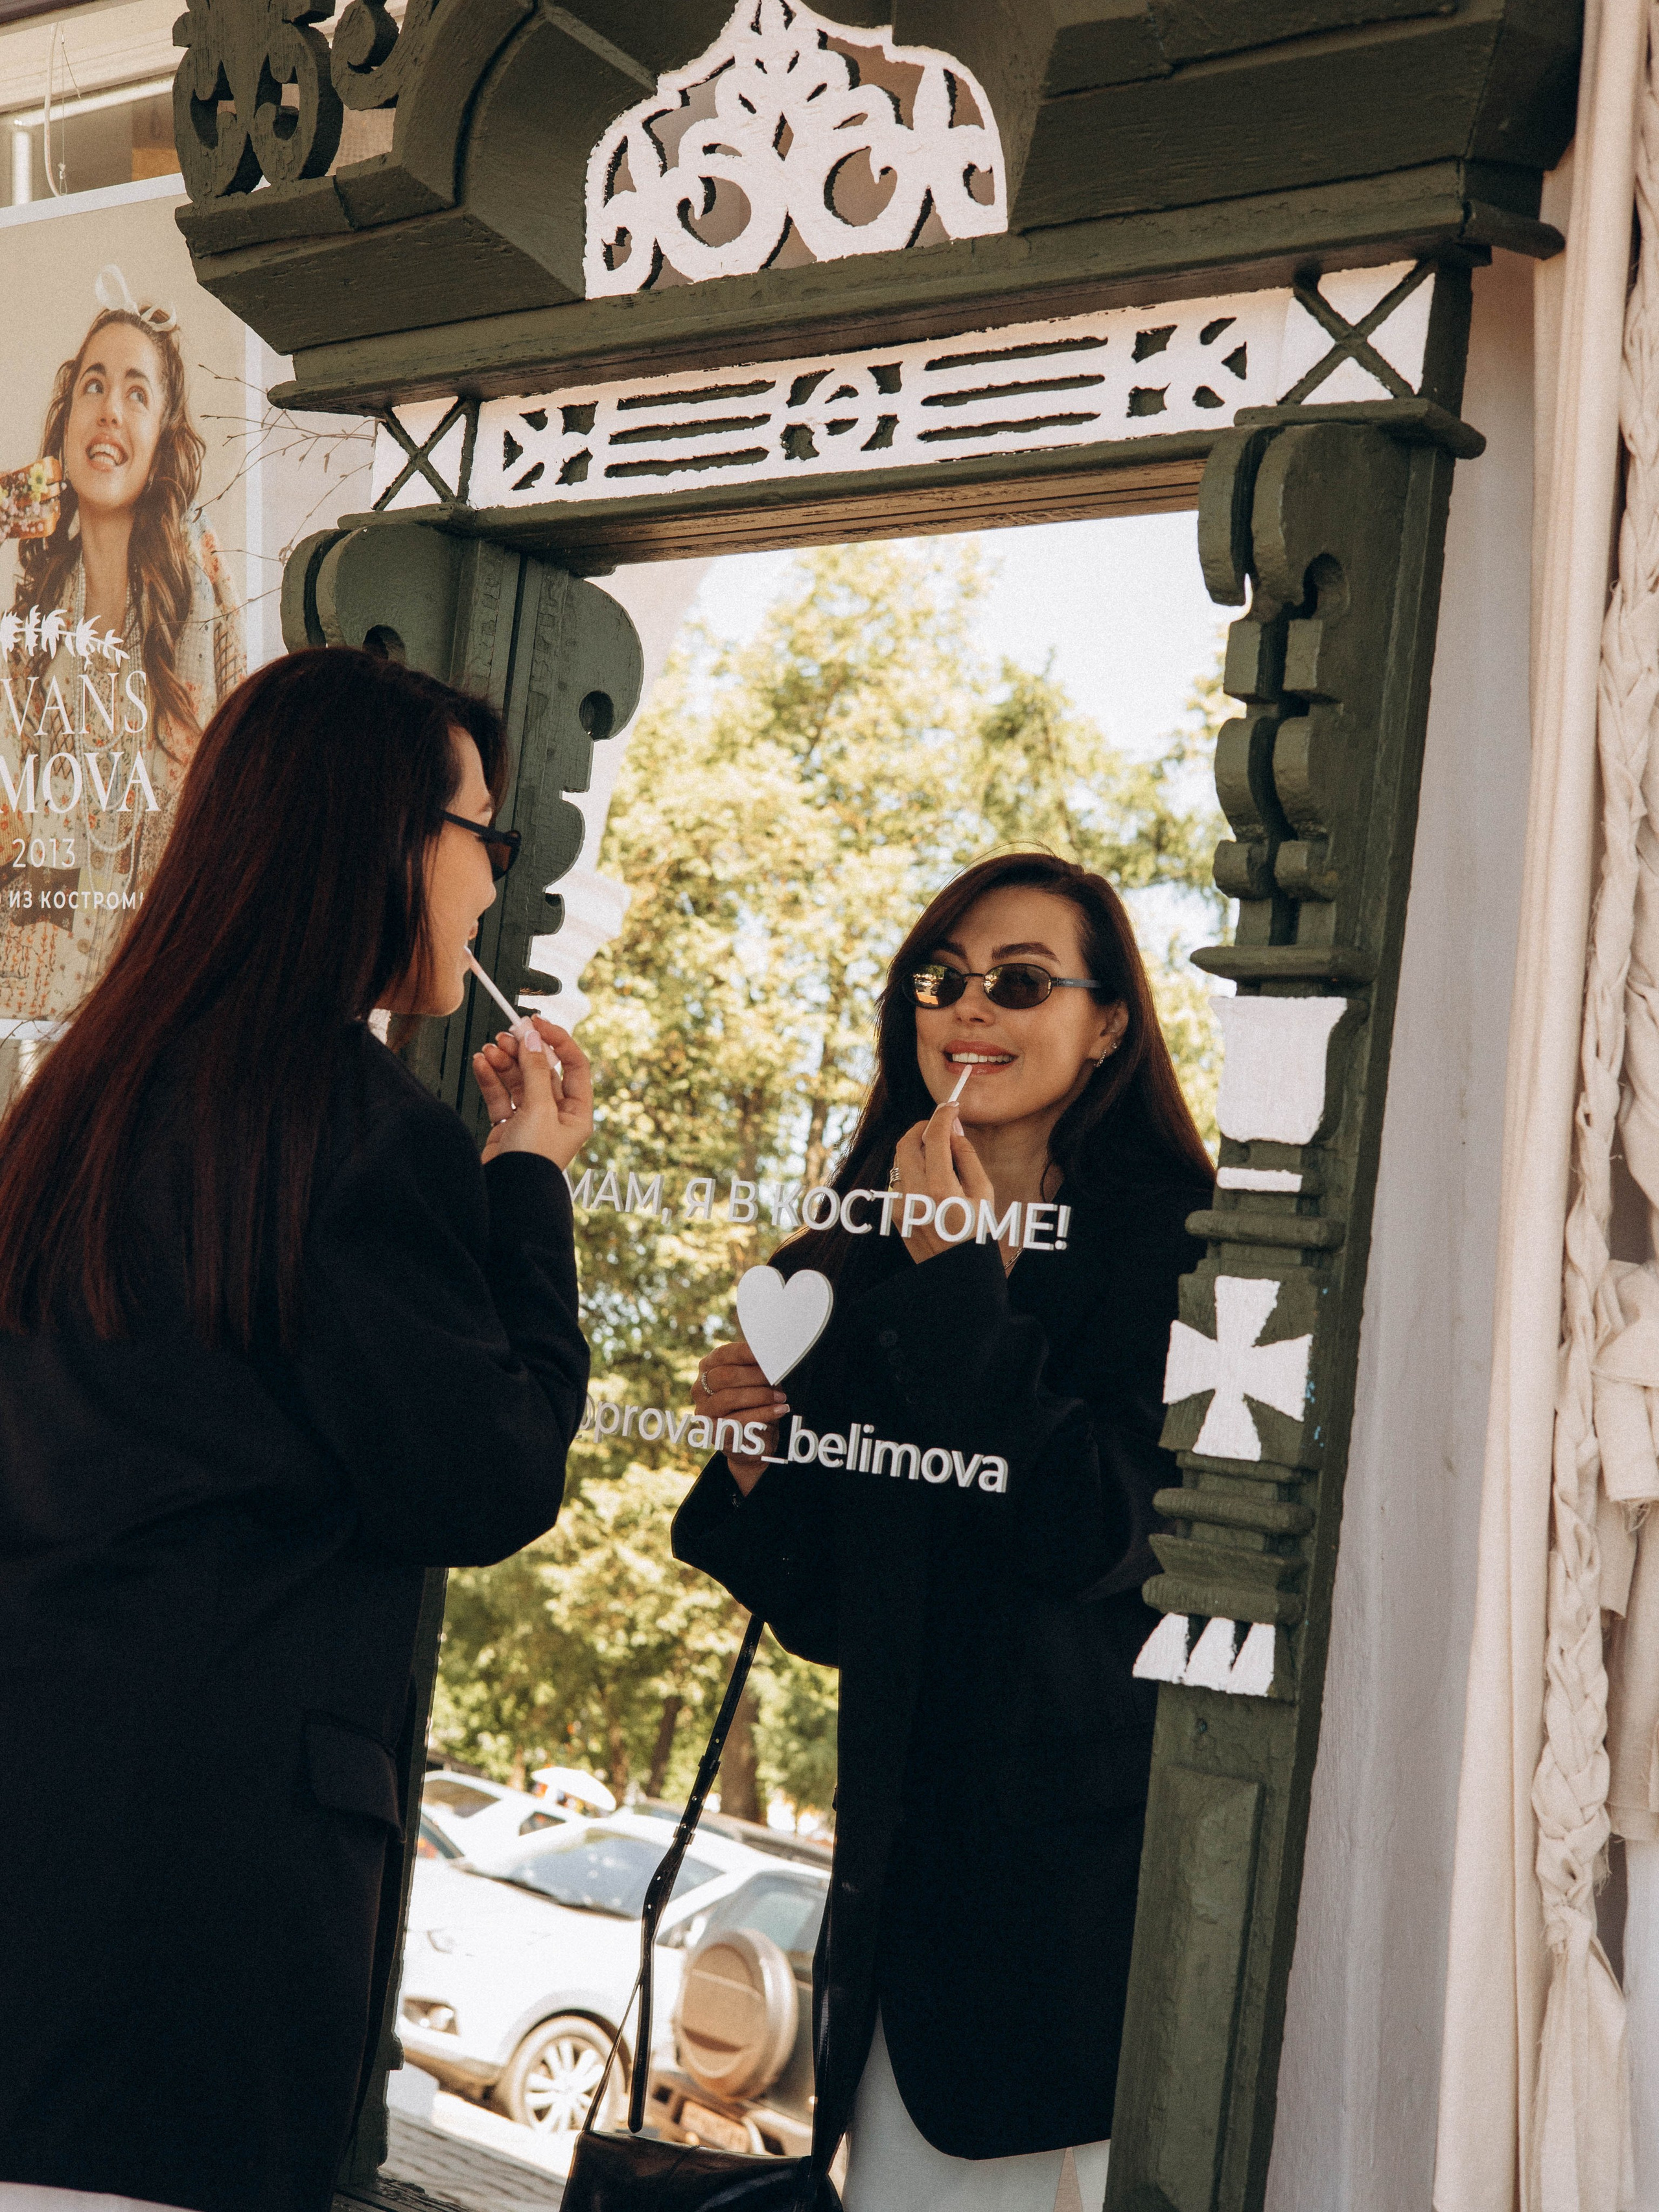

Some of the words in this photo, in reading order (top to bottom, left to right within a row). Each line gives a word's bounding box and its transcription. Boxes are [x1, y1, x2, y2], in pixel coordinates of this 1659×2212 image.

[0, 670, 148, 736] VANS
[0, 751, 162, 814] MOVA
[12, 838, 76, 868] 2013
[9, 890, 33, 909] ИЗ
[41, 891, 144, 910] КОСТРОМ
[684, 1177, 716, 1220] Я
[728, 1180, 761, 1224] В
[771, 1183, 1072, 1252] КОСТРОМЕ!
